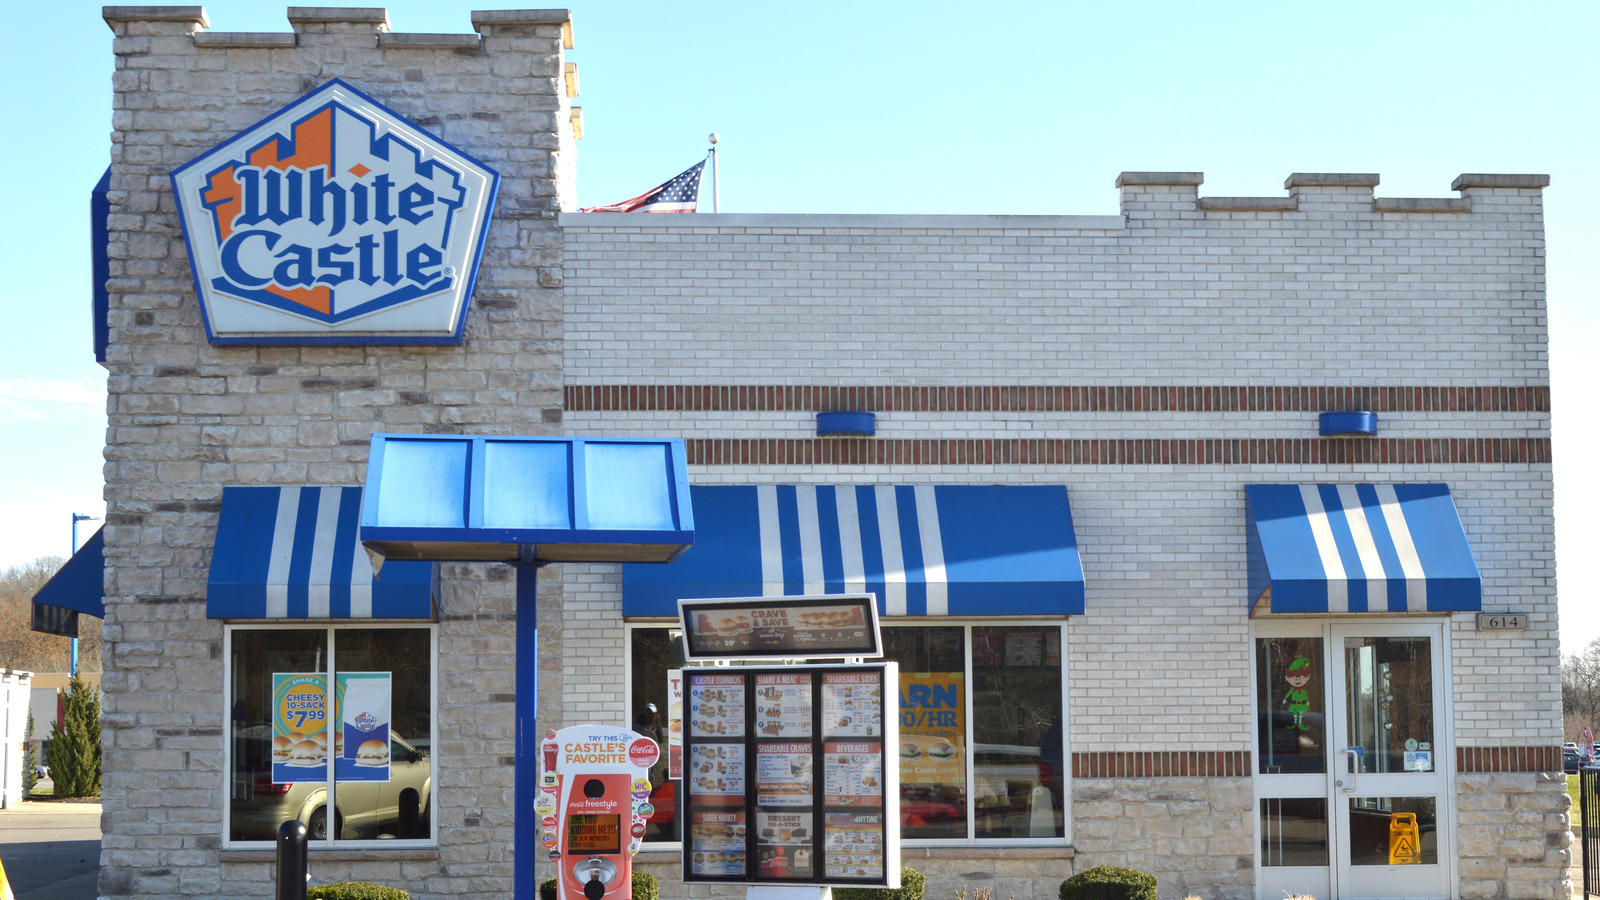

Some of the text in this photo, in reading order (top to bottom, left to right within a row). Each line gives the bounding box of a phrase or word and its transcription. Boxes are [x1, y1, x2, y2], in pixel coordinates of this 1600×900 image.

[234, 167, 434, 237] White
[220, 229, 443, 287] Castle
[751, 610, 788, 618] CRAVE
[762, 618, 789, 626] SAVE
[1489, 616, 1519, 628] 614
[292, 677, 313, 686] SHARE
[695, 676, 741, 685] CASTLE COMBOS
[757, 676, 776, 684] SHARE
[782, 676, 797, 684] MEAL
[827, 674, 878, 683] SHAREABLE SIDES
[286, 693, 326, 701] CHEESY
[899, 711, 957, 727] 0/HR
[564, 743, 626, 753] CASTLE'S
[758, 744, 812, 753] SHAREABLE CRAVES
[837, 744, 869, 753] BEVERAGES
[565, 754, 626, 764] FAVORITE
[585, 800, 618, 809] freestyle
[571, 815, 597, 824] ARE YOU
[702, 813, 737, 822] SLIDER VARIETY
[855, 815, 878, 823] ANYTIME
[570, 825, 597, 834] KIDDING
